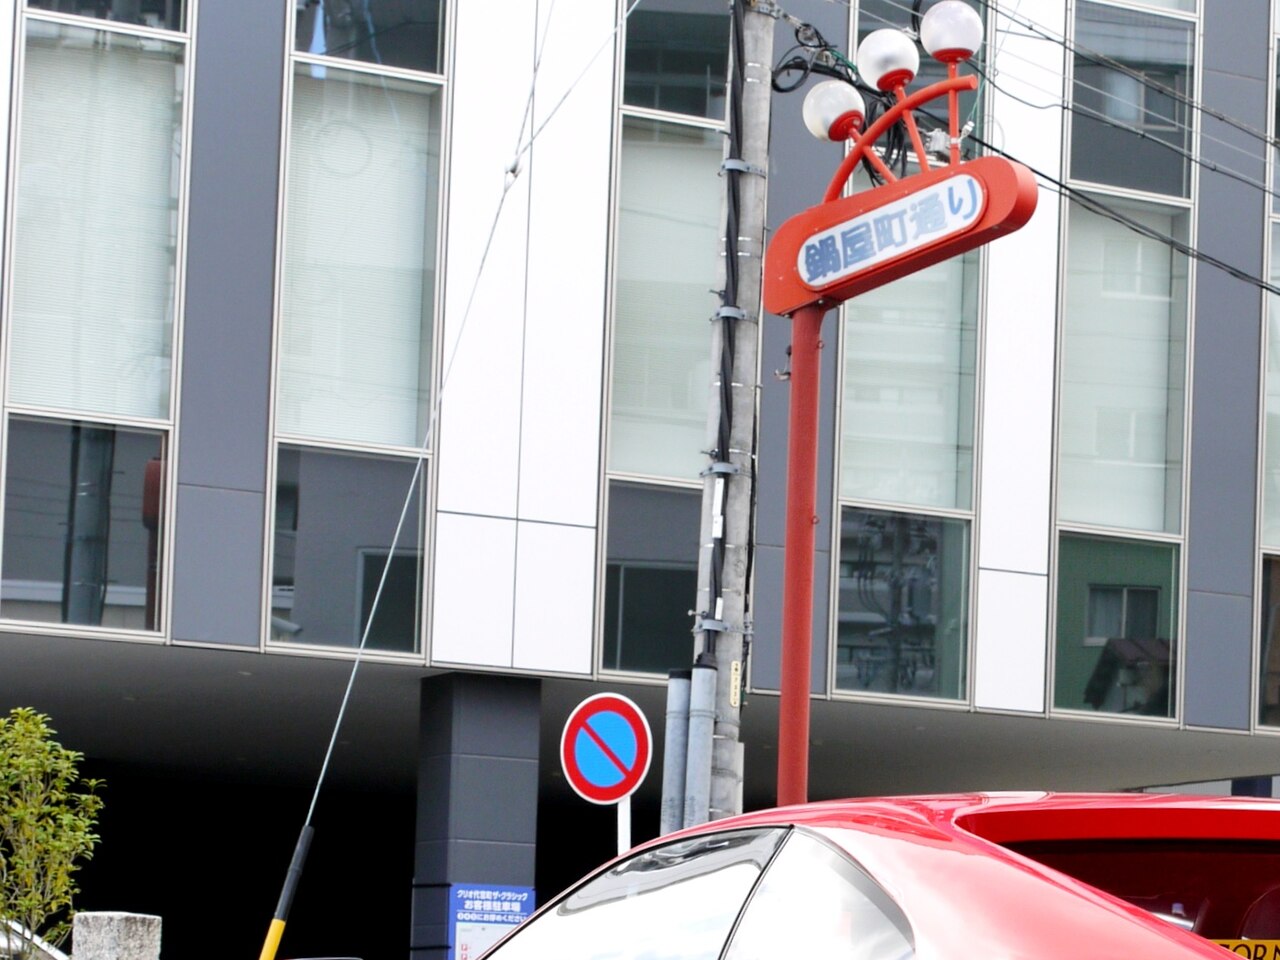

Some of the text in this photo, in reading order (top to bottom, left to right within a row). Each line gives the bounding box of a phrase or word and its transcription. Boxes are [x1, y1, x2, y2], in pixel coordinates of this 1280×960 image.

[804, 178, 978, 283] 鍋屋町通り
[463, 899, 522, 912] お客様駐車場
